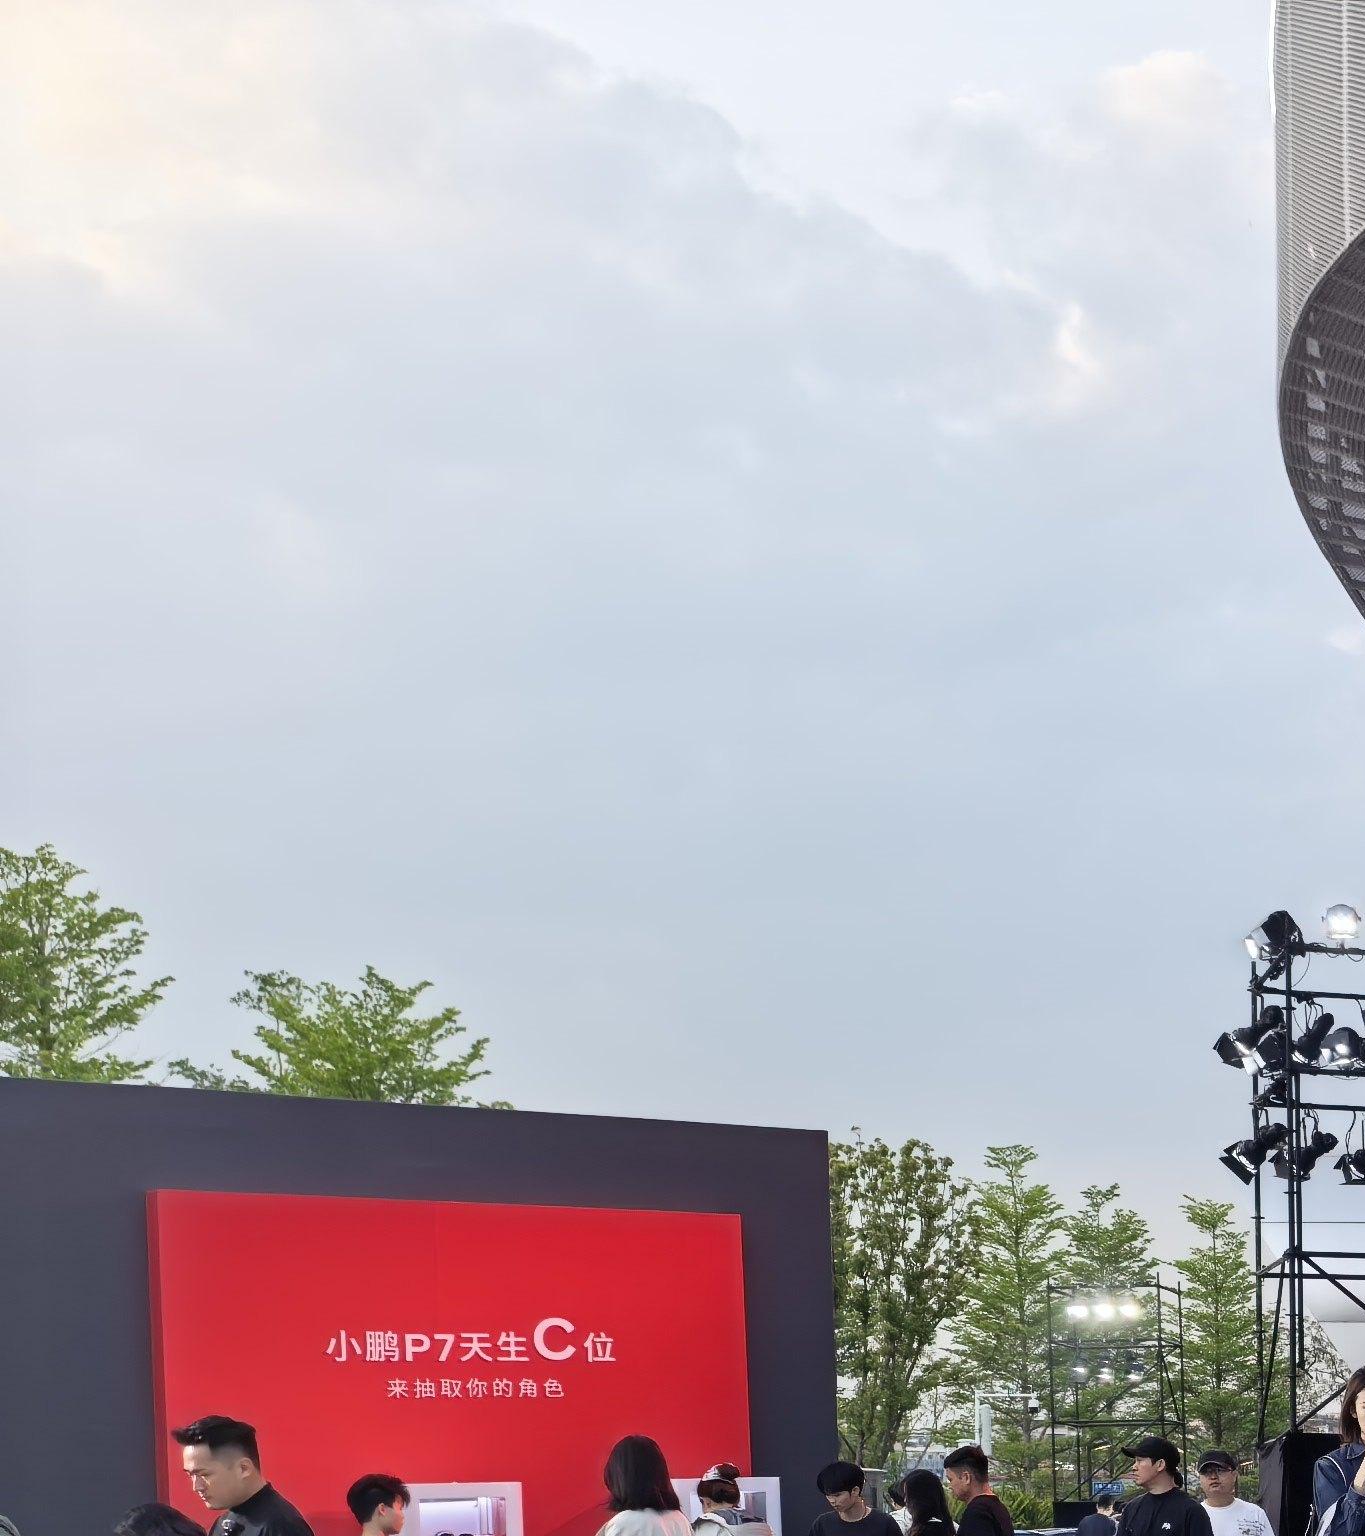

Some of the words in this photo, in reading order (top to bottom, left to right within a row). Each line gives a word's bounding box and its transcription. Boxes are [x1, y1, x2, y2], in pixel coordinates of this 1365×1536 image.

[325, 1317, 617, 1363] 小鹏P7天生C位
[387, 1378, 565, 1399] 来抽取你的角色
